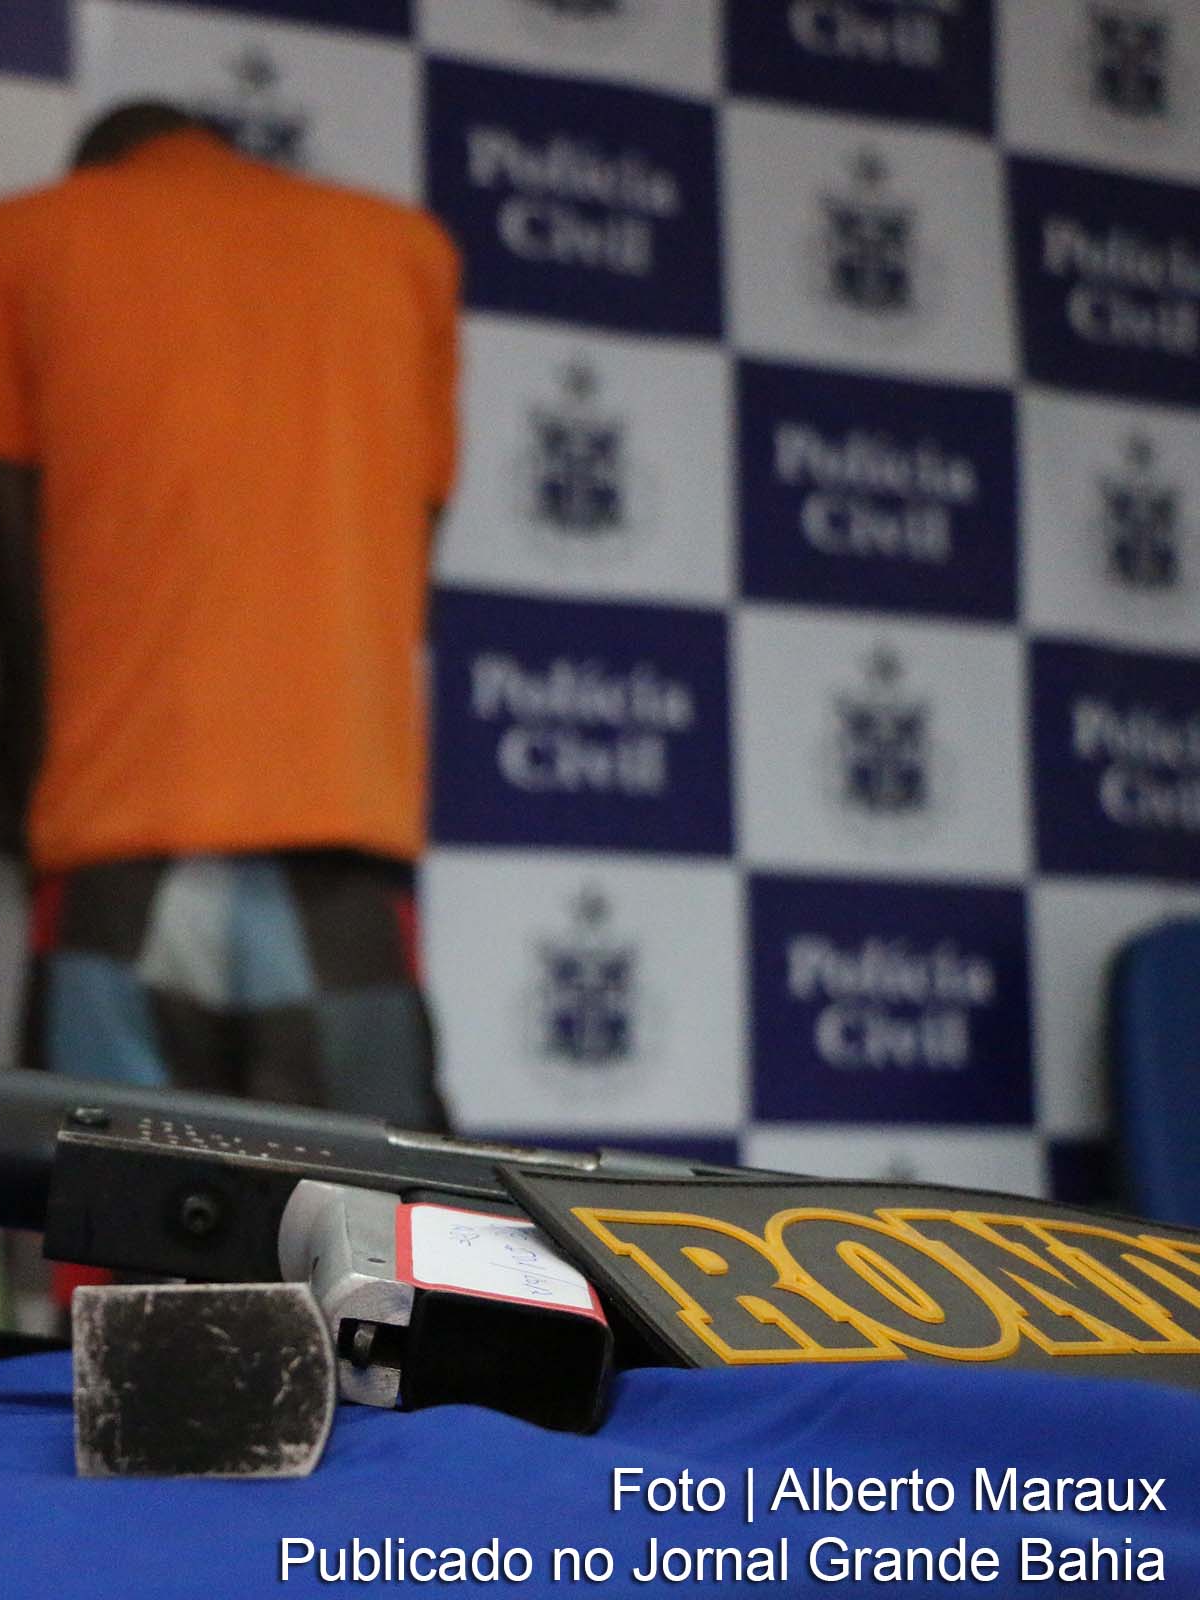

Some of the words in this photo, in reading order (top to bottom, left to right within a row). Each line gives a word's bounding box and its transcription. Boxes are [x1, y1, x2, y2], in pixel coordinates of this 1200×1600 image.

[500, 197, 655, 276] Civil
[800, 493, 953, 562] Civil
[499, 727, 668, 795] Civil
[814, 1003, 972, 1068] Civil
